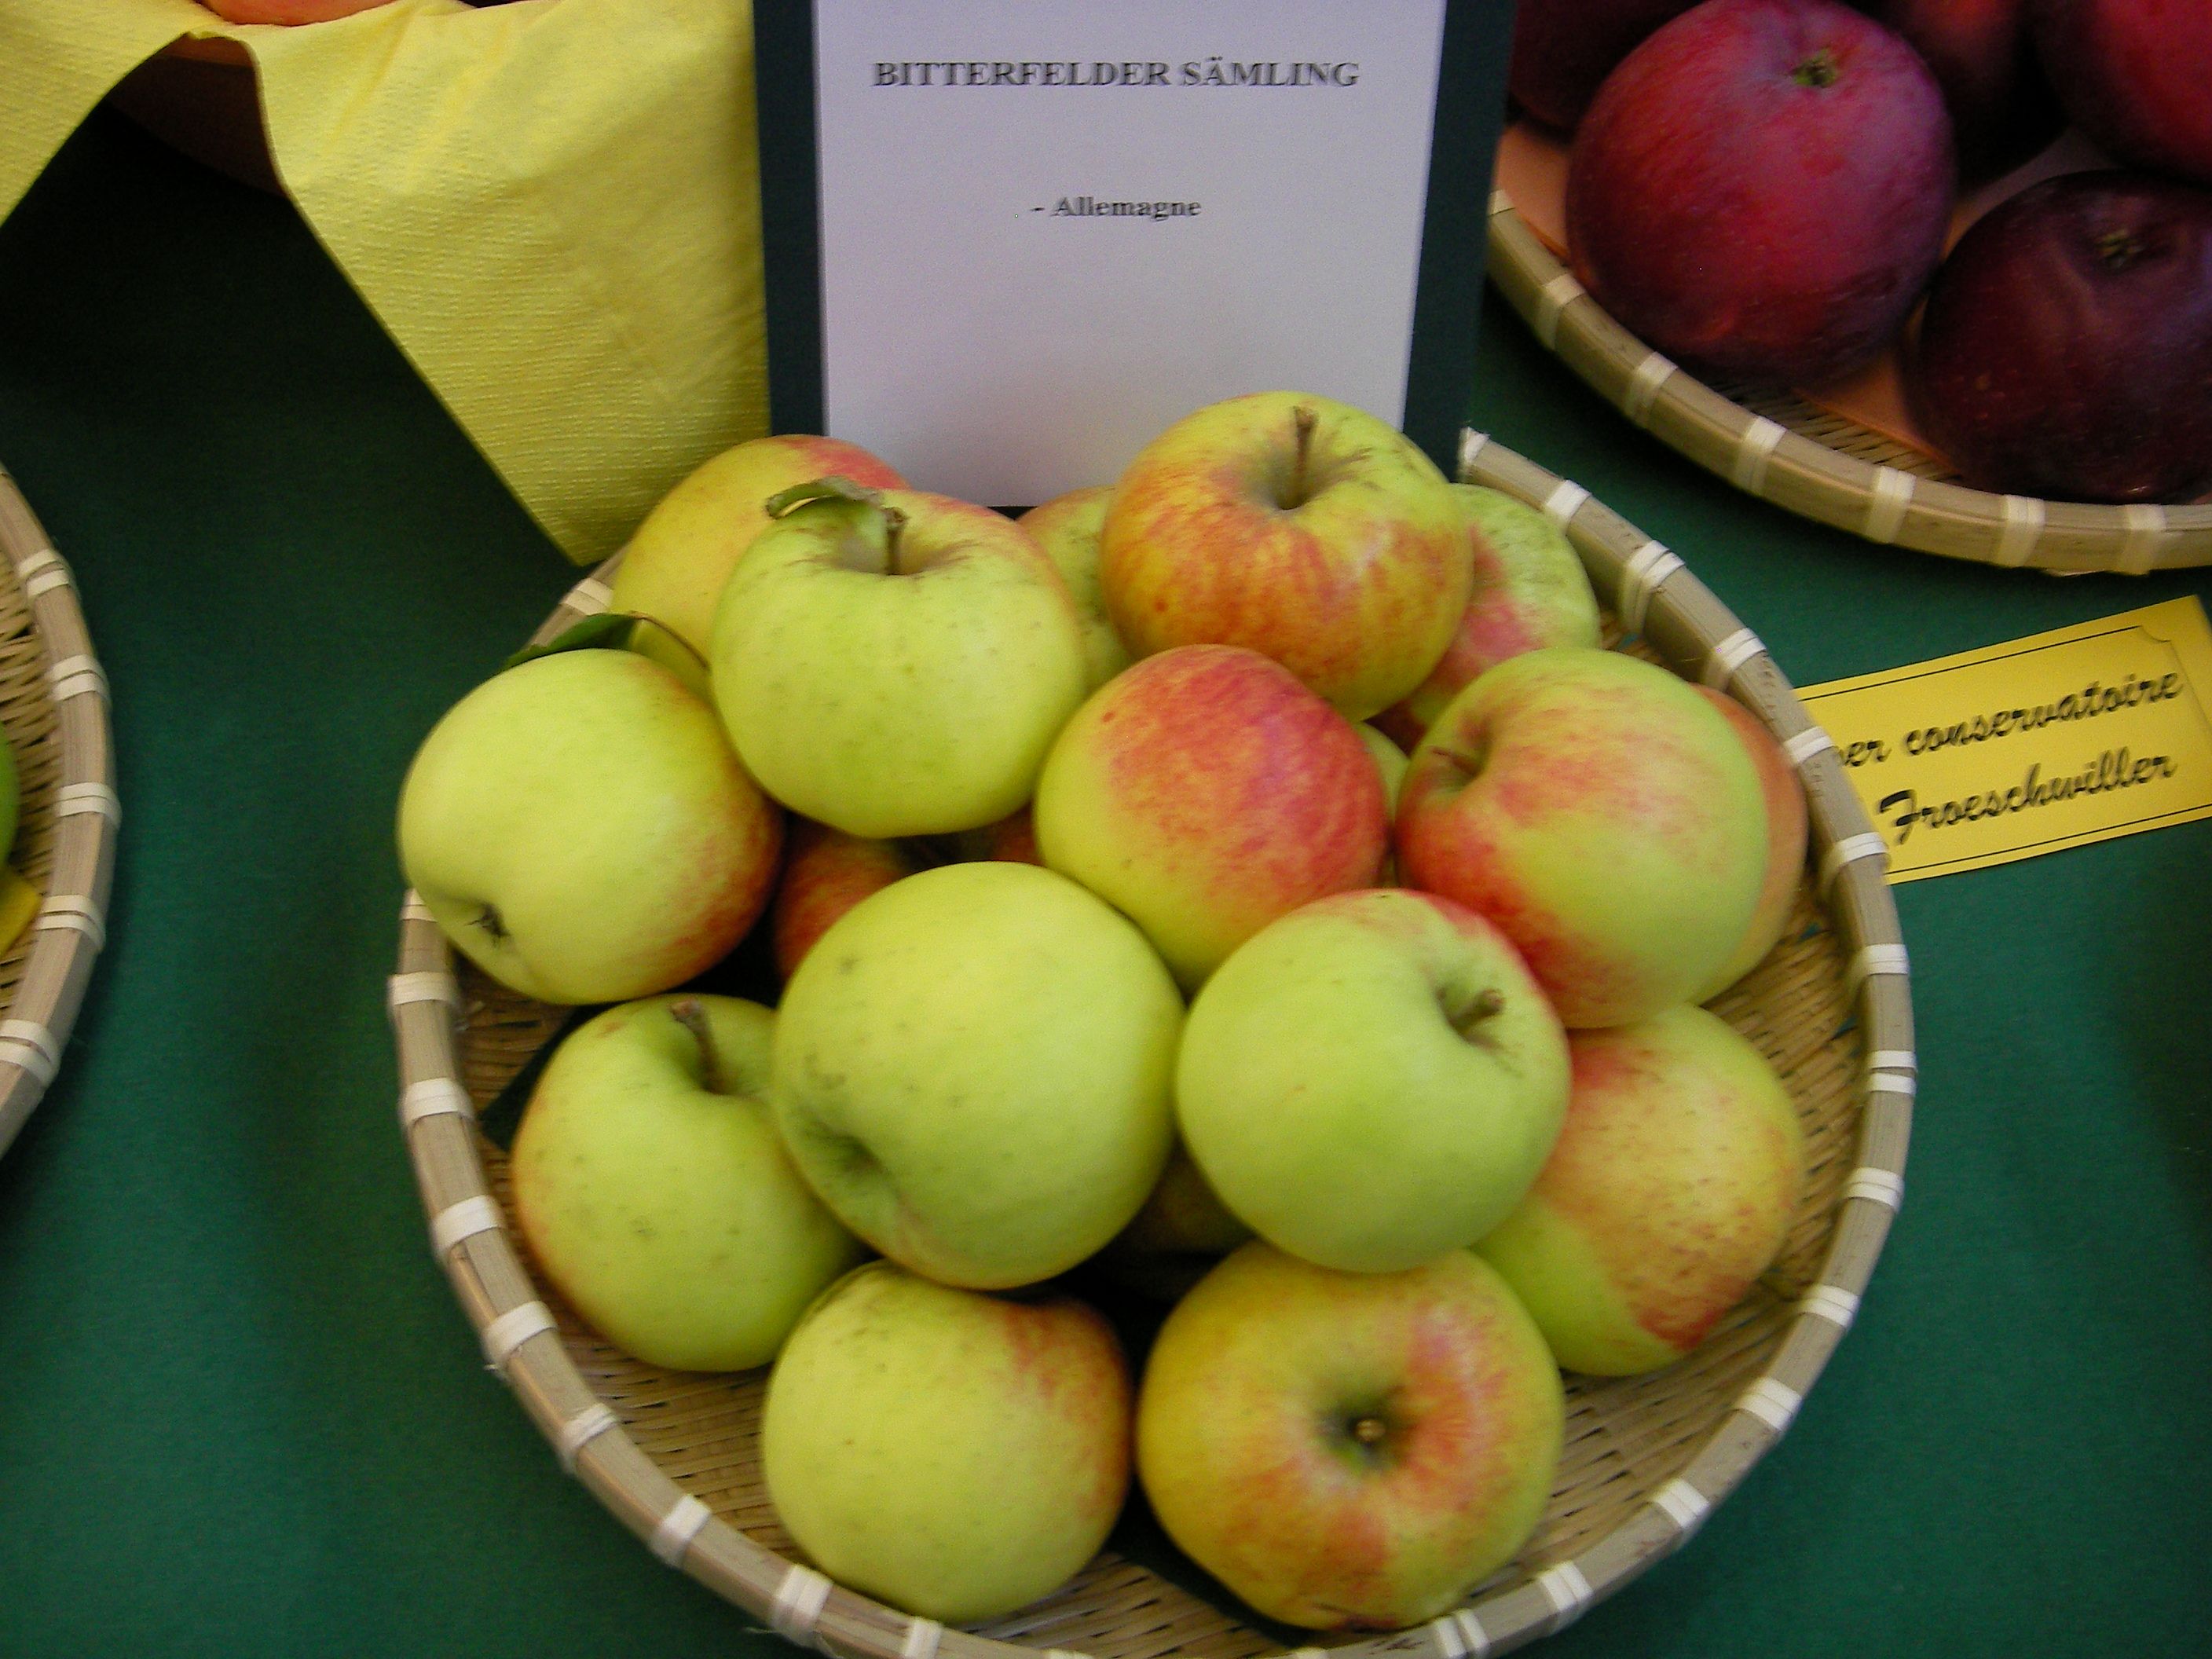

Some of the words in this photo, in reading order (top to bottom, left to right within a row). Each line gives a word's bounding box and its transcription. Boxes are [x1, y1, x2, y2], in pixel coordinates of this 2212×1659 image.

[873, 60, 1172, 86] BITTERFELDER
[1181, 54, 1360, 87] SÄMLING
[1052, 196, 1202, 222] Allemagne
[1837, 739, 1892, 767] er
[1903, 672, 2183, 756] conservatoire
[1877, 746, 2177, 844] Froeschwiller
